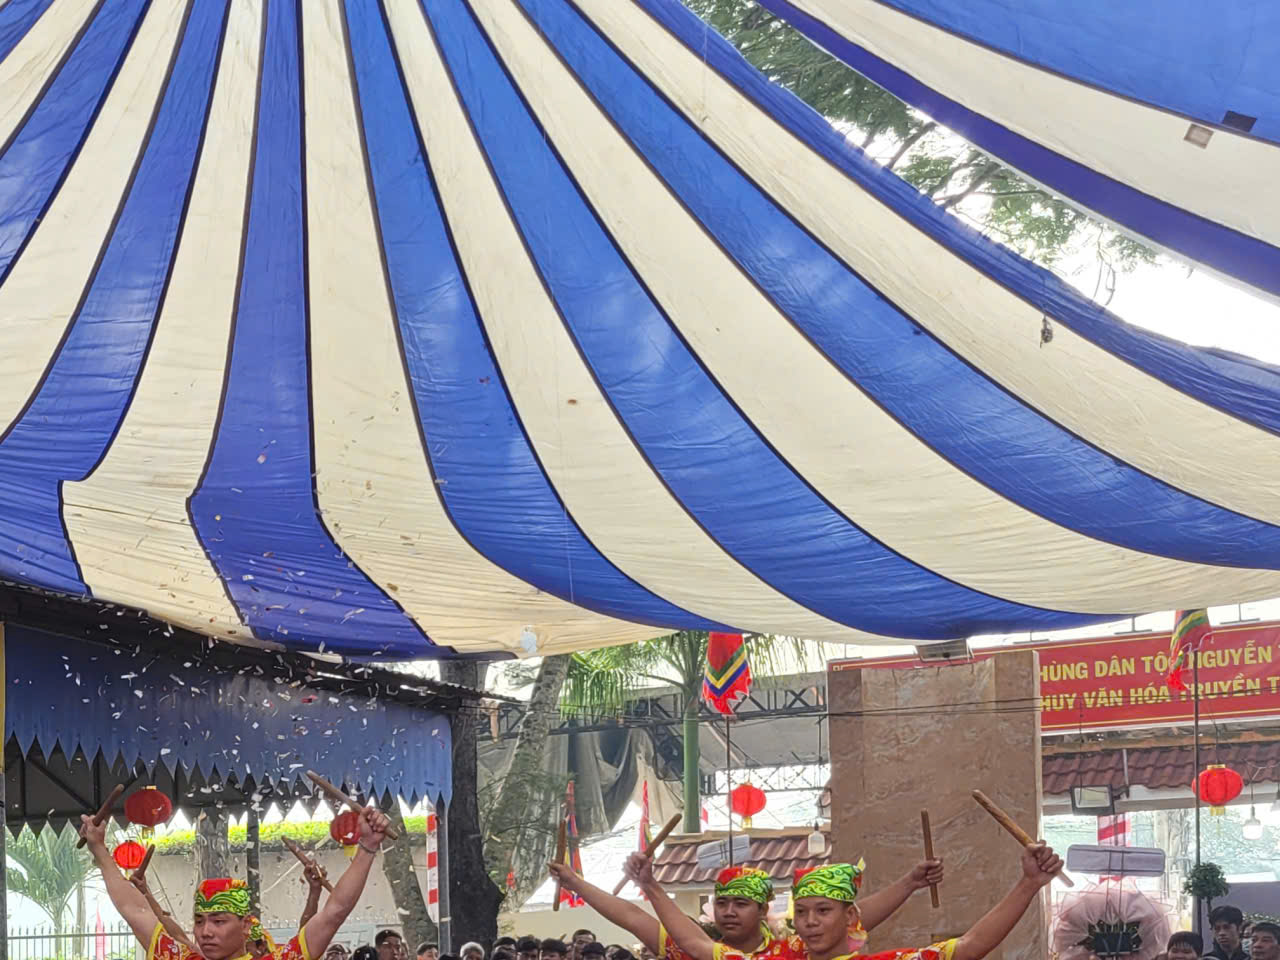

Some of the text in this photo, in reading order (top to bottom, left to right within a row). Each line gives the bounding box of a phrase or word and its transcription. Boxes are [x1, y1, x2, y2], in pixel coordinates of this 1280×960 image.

[1094, 654, 1136, 678] DÂN
[1140, 650, 1172, 676] TỘ
[1040, 691, 1077, 713] HUY
[1082, 685, 1124, 709] VĂN
[1129, 680, 1172, 704] HÓA
